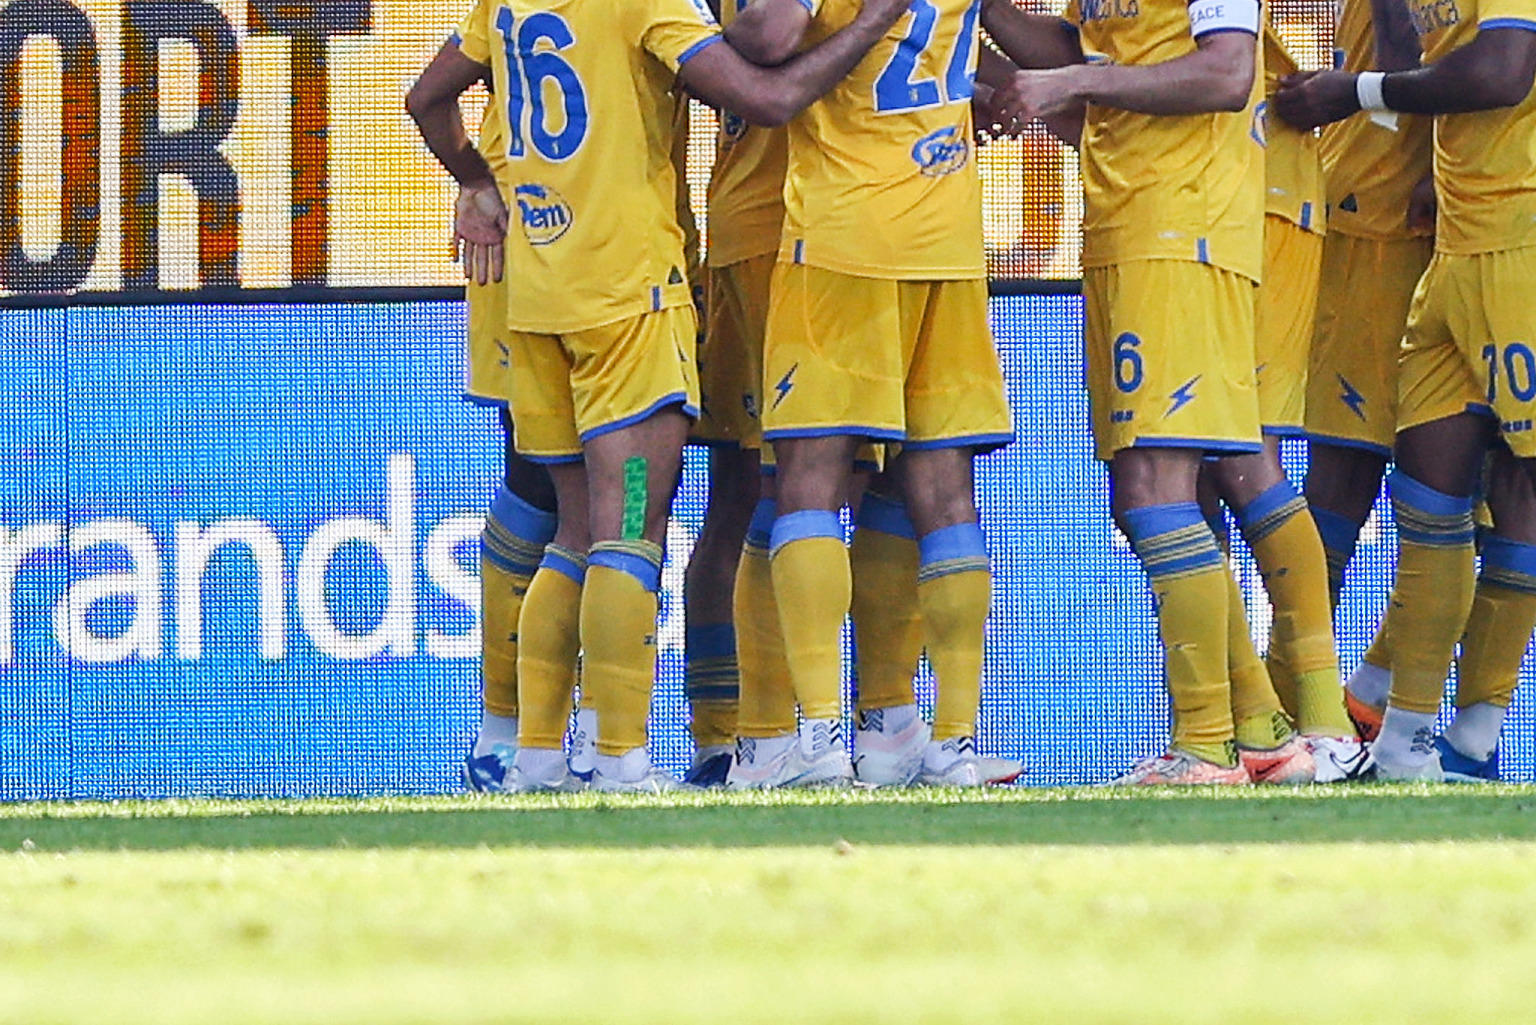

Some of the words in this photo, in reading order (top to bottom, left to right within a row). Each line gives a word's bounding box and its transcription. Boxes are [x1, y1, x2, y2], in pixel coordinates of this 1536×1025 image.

[494, 4, 591, 164] 16
[1113, 331, 1143, 393] 6
[0, 452, 484, 664] rands
